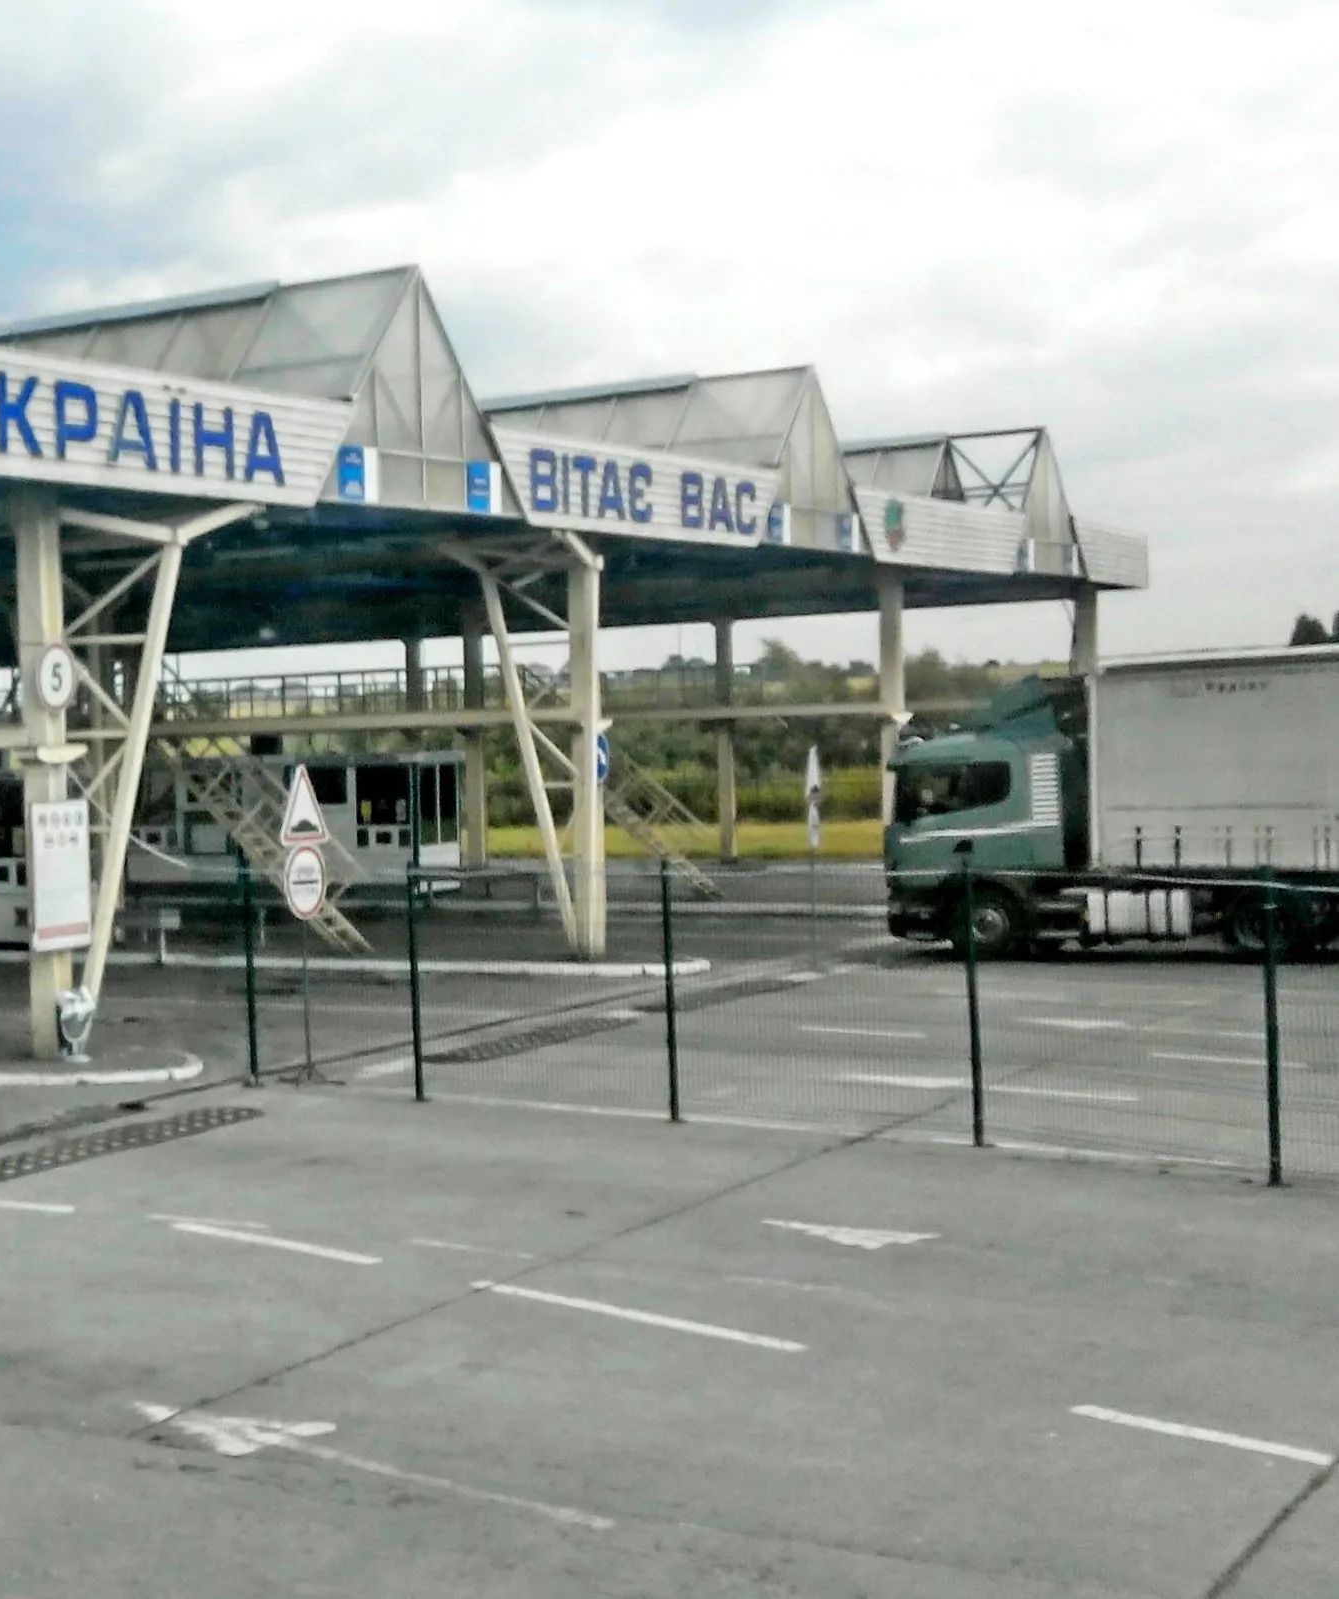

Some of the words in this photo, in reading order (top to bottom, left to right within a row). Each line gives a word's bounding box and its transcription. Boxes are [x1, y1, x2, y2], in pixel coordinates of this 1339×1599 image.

[530, 448, 653, 523] ВІТАЄ
[681, 471, 756, 535] ВАС
[50, 662, 63, 692] 5
